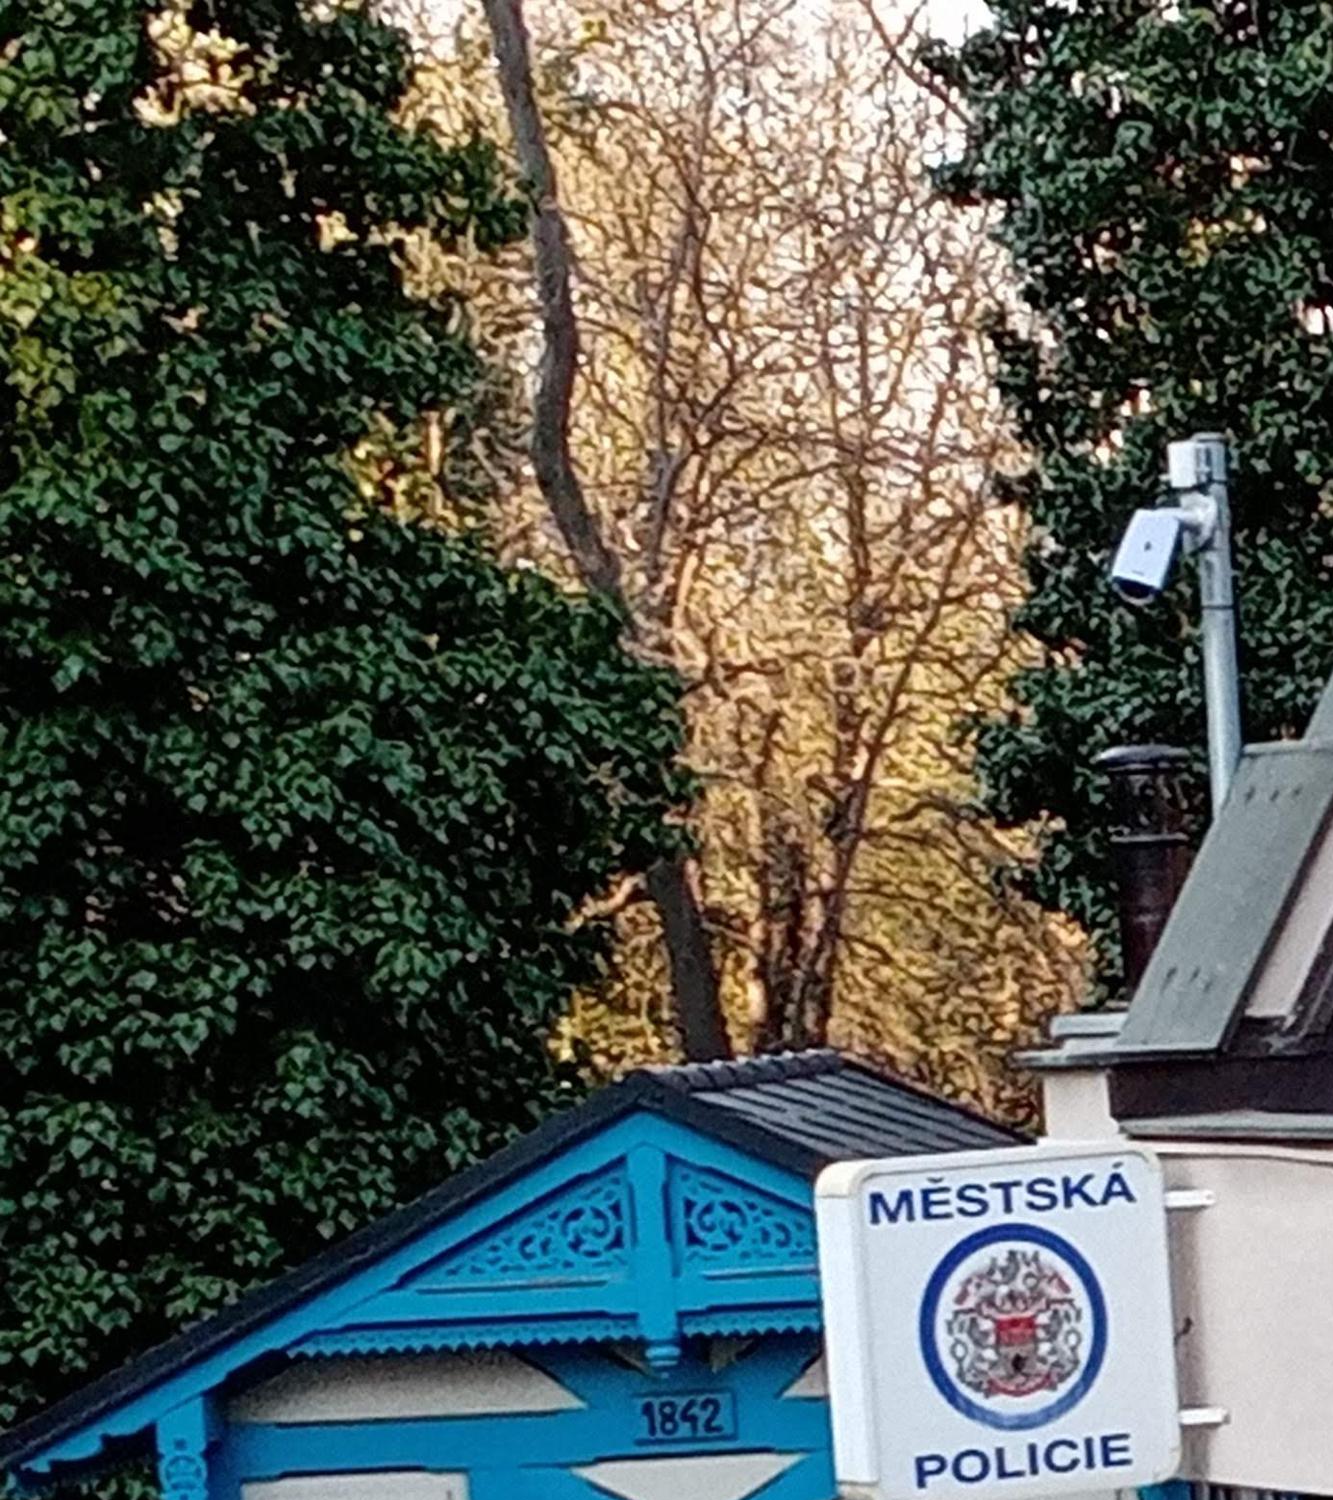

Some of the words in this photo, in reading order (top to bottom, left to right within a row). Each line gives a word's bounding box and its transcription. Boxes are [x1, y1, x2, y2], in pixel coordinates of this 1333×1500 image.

[868, 1162, 1137, 1226] MĚSTSKÁ
[641, 1397, 724, 1438] 1842
[914, 1433, 1134, 1490] POLICIE
